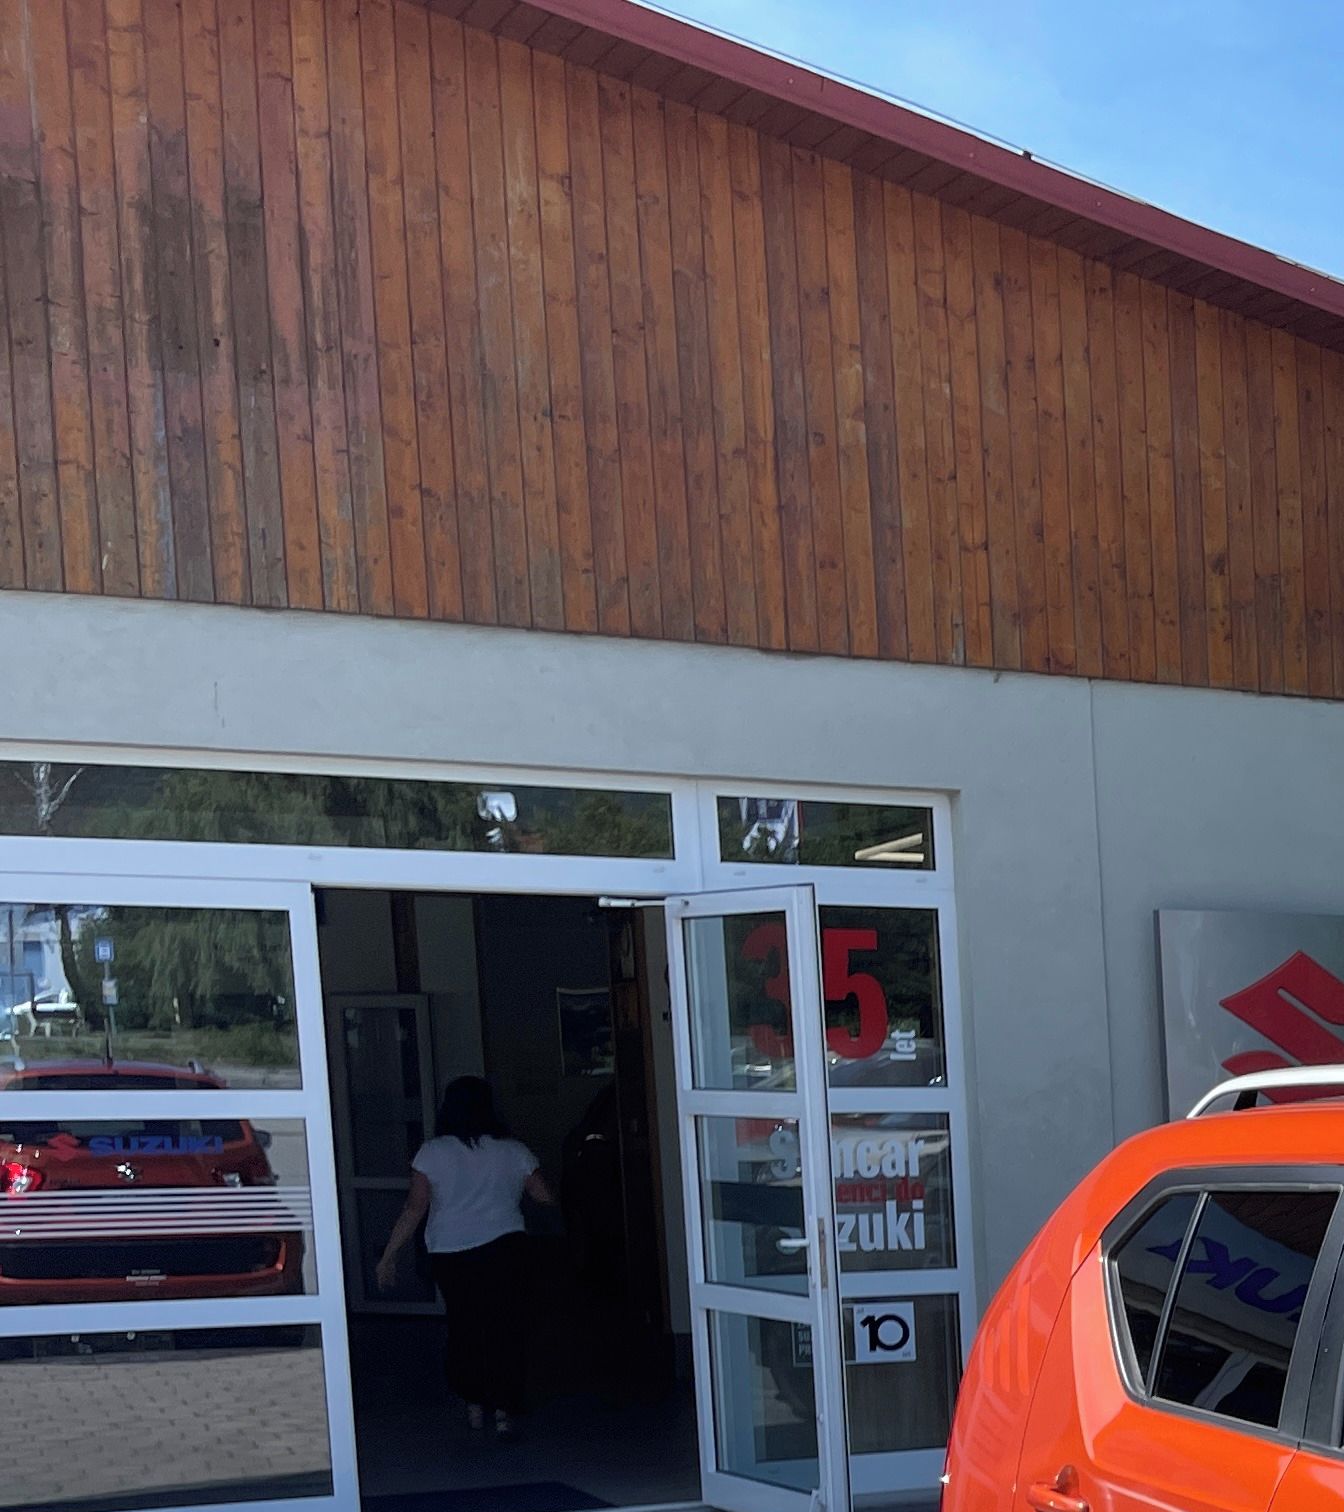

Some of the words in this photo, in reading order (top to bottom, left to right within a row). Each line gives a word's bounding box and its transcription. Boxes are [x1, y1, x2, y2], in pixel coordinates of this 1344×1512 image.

[889, 1029, 917, 1061] let
[88, 1135, 224, 1158] SUZUKI
[836, 1200, 926, 1251] zuki
[860, 1314, 910, 1352] 10
